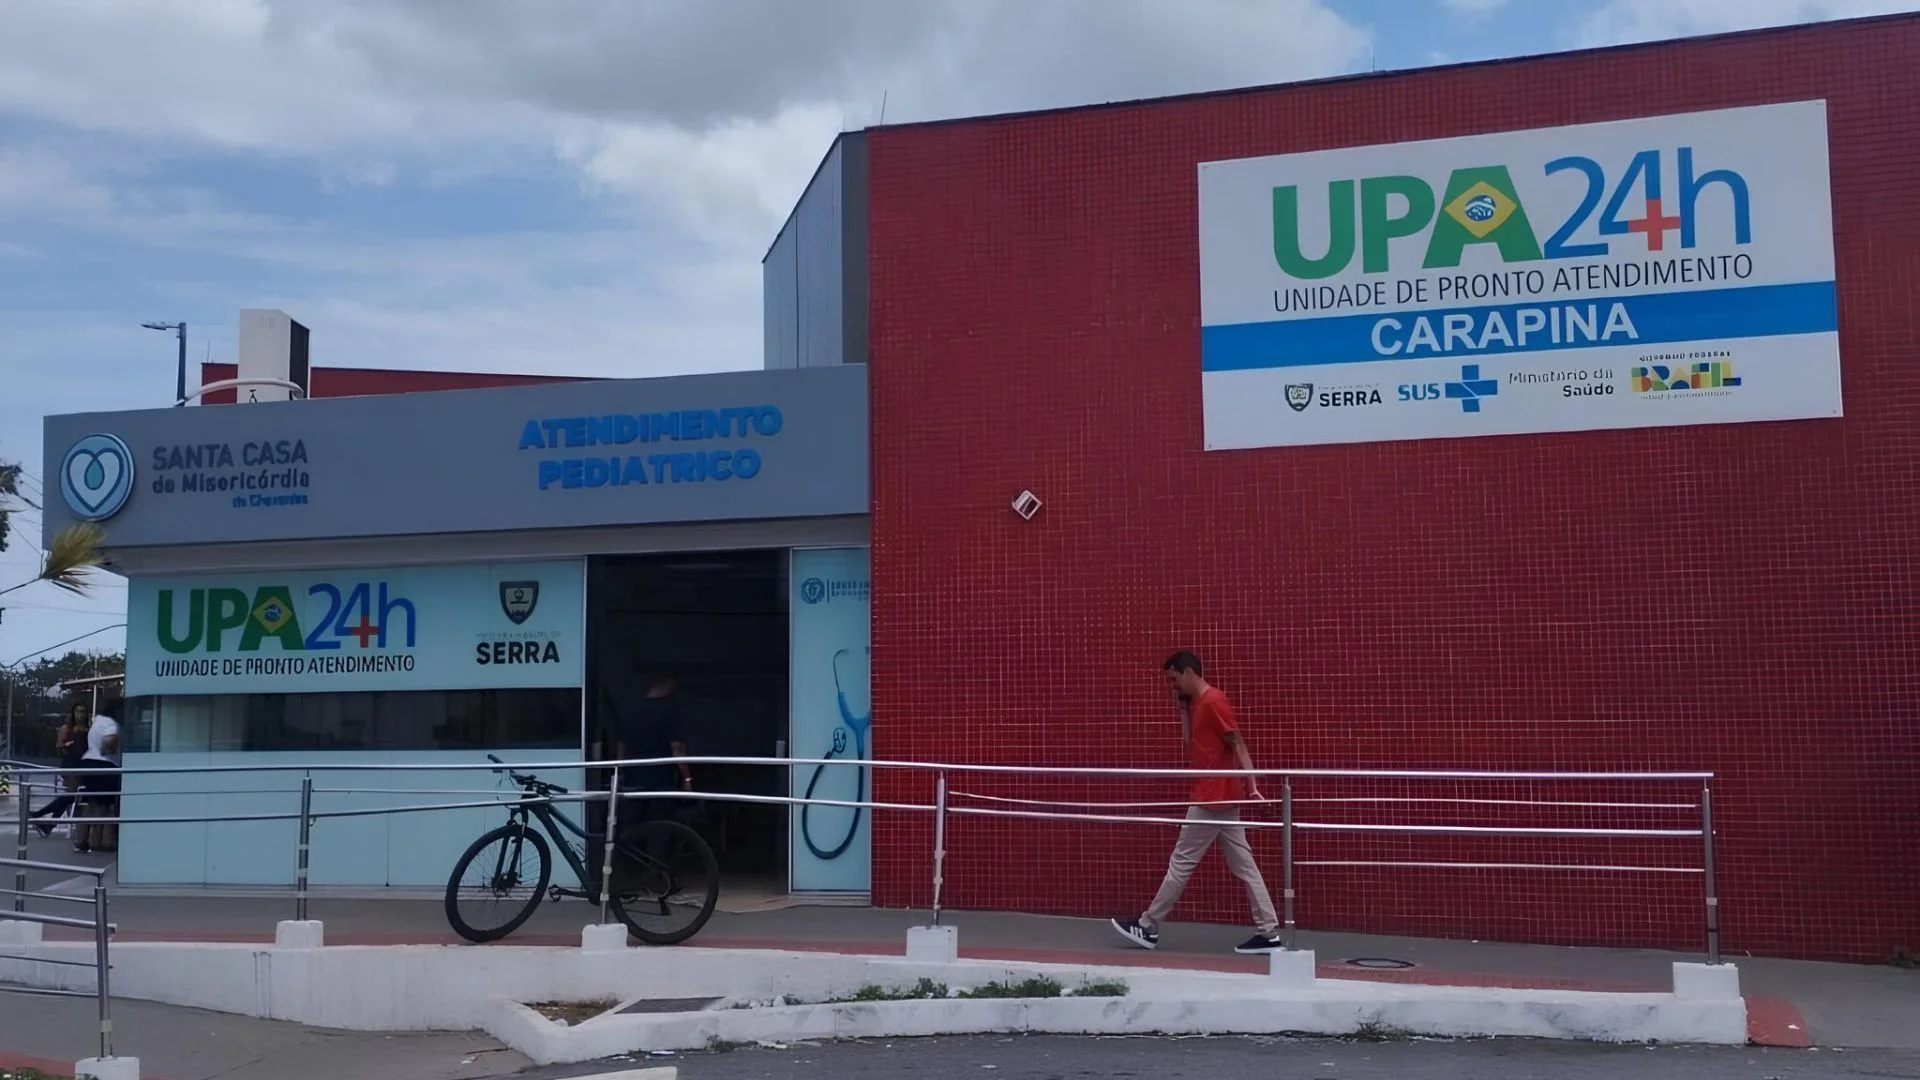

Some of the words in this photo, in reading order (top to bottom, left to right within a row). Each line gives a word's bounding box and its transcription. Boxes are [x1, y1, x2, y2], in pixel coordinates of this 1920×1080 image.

[1272, 165, 1543, 280] UPA
[1543, 147, 1752, 260] 24h
[1274, 281, 1386, 313] UNIDADE
[1396, 278, 1428, 304] DE
[1438, 269, 1544, 301] PRONTO
[1553, 253, 1753, 293] ATENDIMENTO
[1371, 302, 1639, 355] CARAPINA
[1319, 389, 1383, 408] SERRA
[1397, 383, 1441, 401] SUS
[517, 404, 784, 450] ATENDIMENTO
[152, 443, 234, 471] SANTA
[242, 439, 308, 466] CASA
[538, 447, 762, 491] PEDIATRICO
[157, 586, 305, 655] UPA
[304, 582, 416, 651] 24h
[155, 659, 219, 677] UNIDADE
[223, 658, 242, 675] DE
[246, 657, 304, 676] PRONTO
[307, 654, 416, 675] ATENDIMENTO
[476, 640, 561, 666] SERRA
